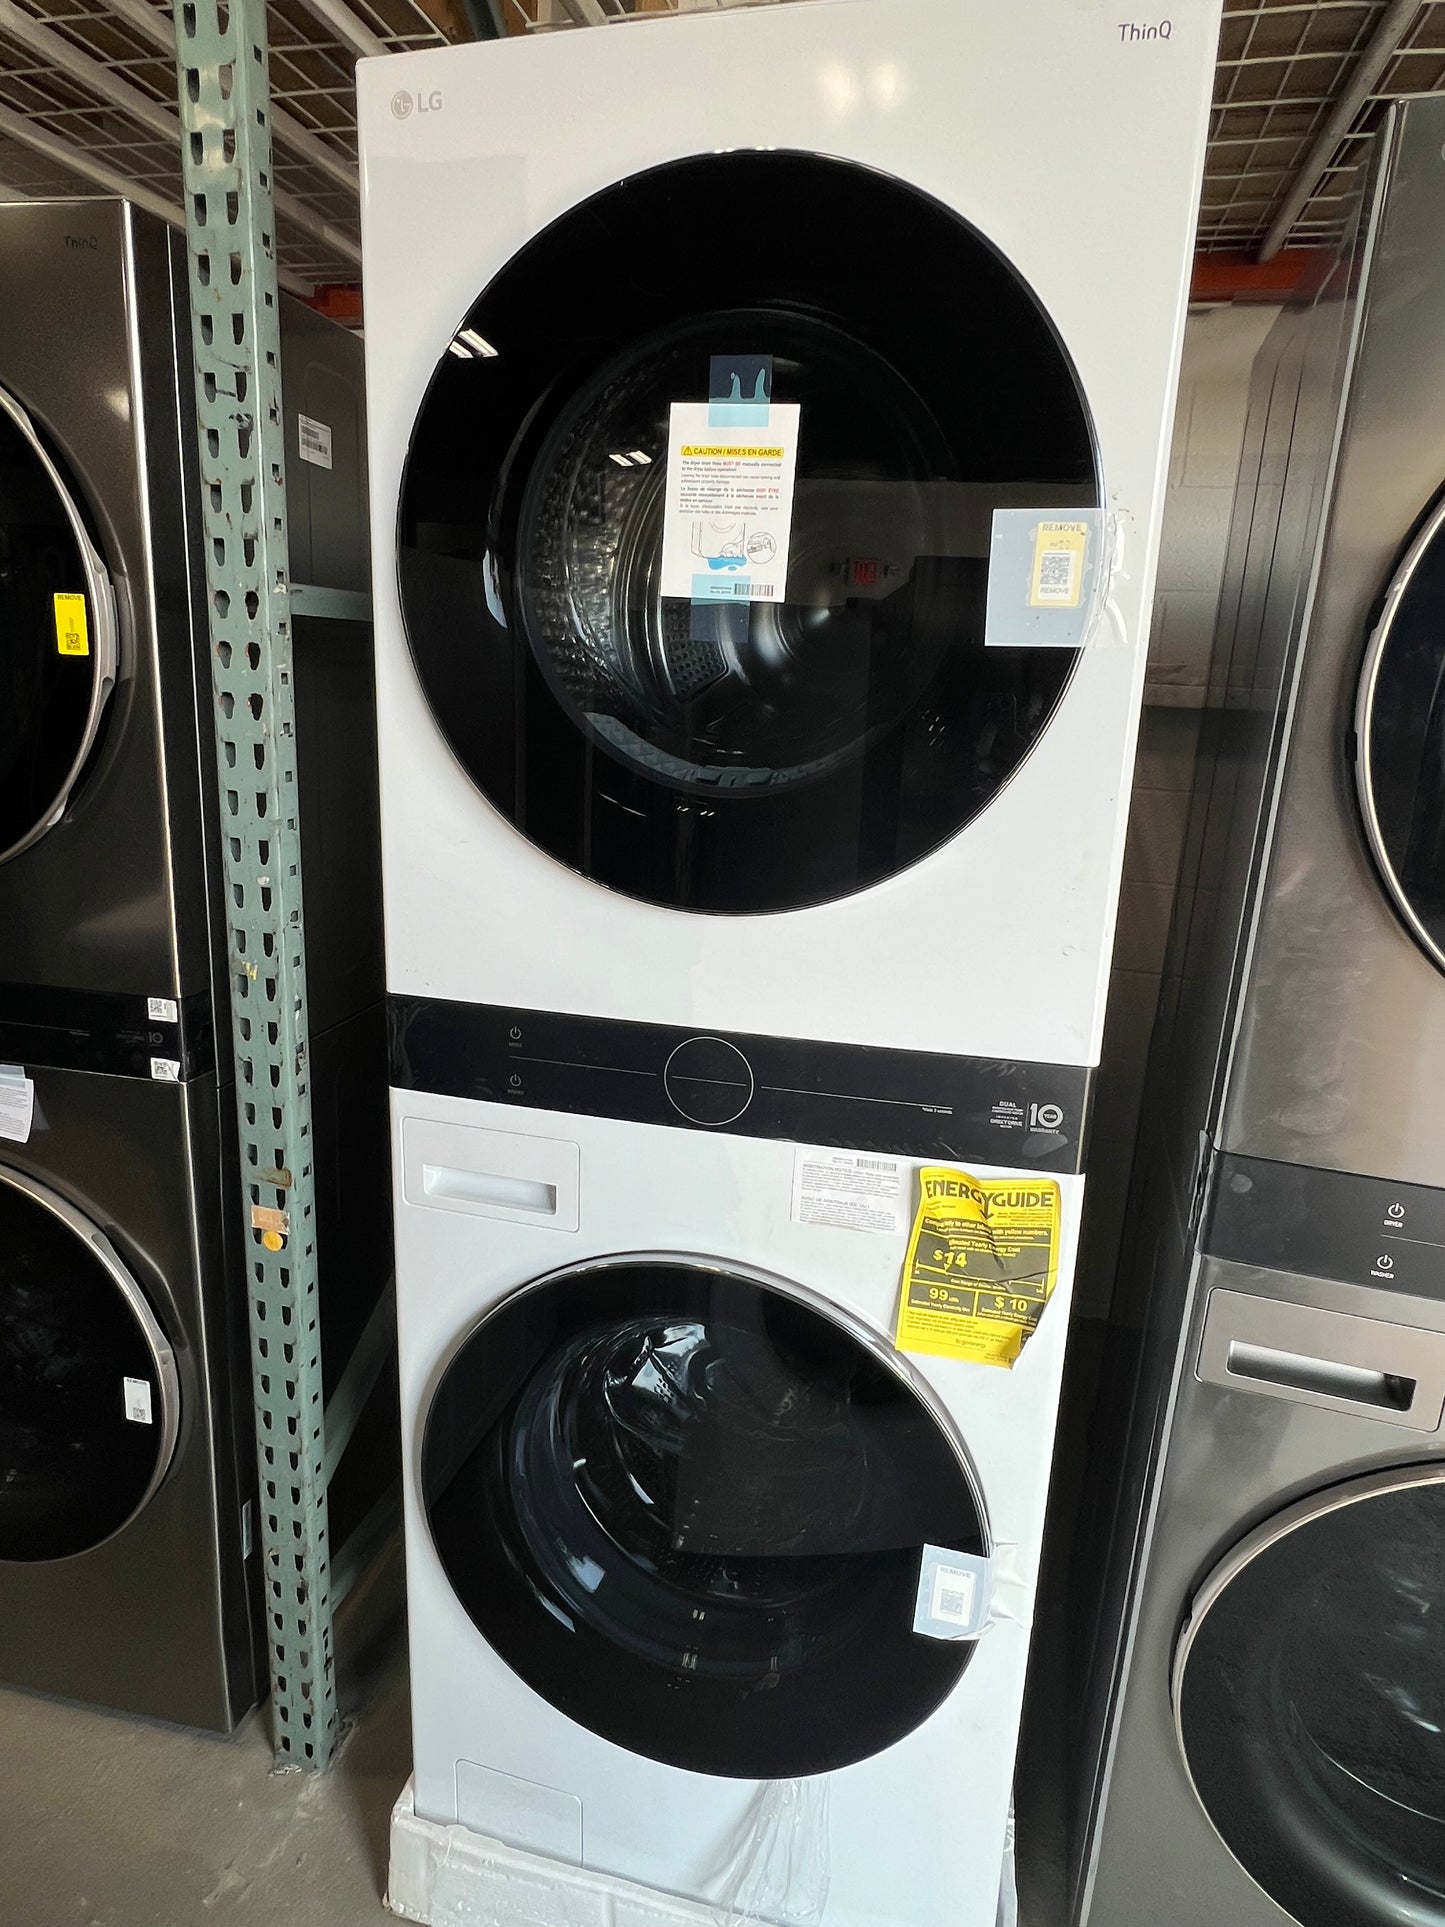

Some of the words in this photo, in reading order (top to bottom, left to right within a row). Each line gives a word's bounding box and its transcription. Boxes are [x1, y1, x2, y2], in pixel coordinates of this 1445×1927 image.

[1118, 20, 1171, 41] ThinQ
[418, 91, 442, 112] LG
[694, 447, 721, 455] CAUTION
[1042, 524, 1082, 532] REMOVE
[1030, 1103, 1064, 1128] 10
[925, 1180, 1054, 1208] ENERGYGUIDE
[933, 1249, 967, 1268] $14
[929, 1287, 949, 1301] 99
[1010, 1298, 1028, 1312] 10
[940, 1567, 971, 1579] REMOVE
